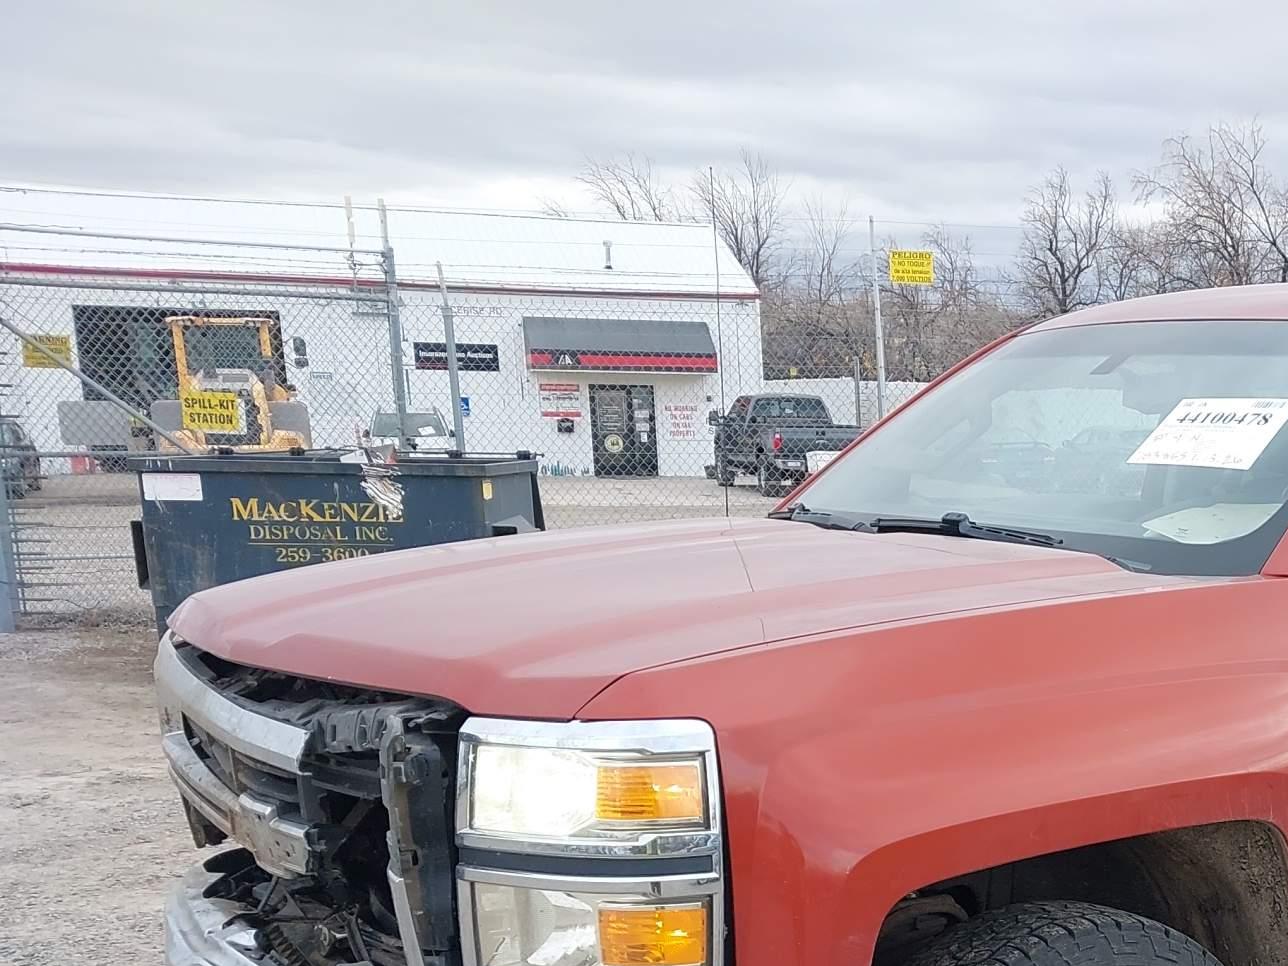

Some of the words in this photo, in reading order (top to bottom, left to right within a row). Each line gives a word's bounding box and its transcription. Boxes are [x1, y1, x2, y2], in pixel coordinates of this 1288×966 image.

[892, 251, 931, 259] PELIGRO
[184, 398, 235, 410] SPILL-KIT
[189, 413, 233, 425] STATION
[1176, 411, 1273, 426] 44100478
[249, 524, 348, 541] DISPOSAL
[355, 526, 395, 542] INC.
